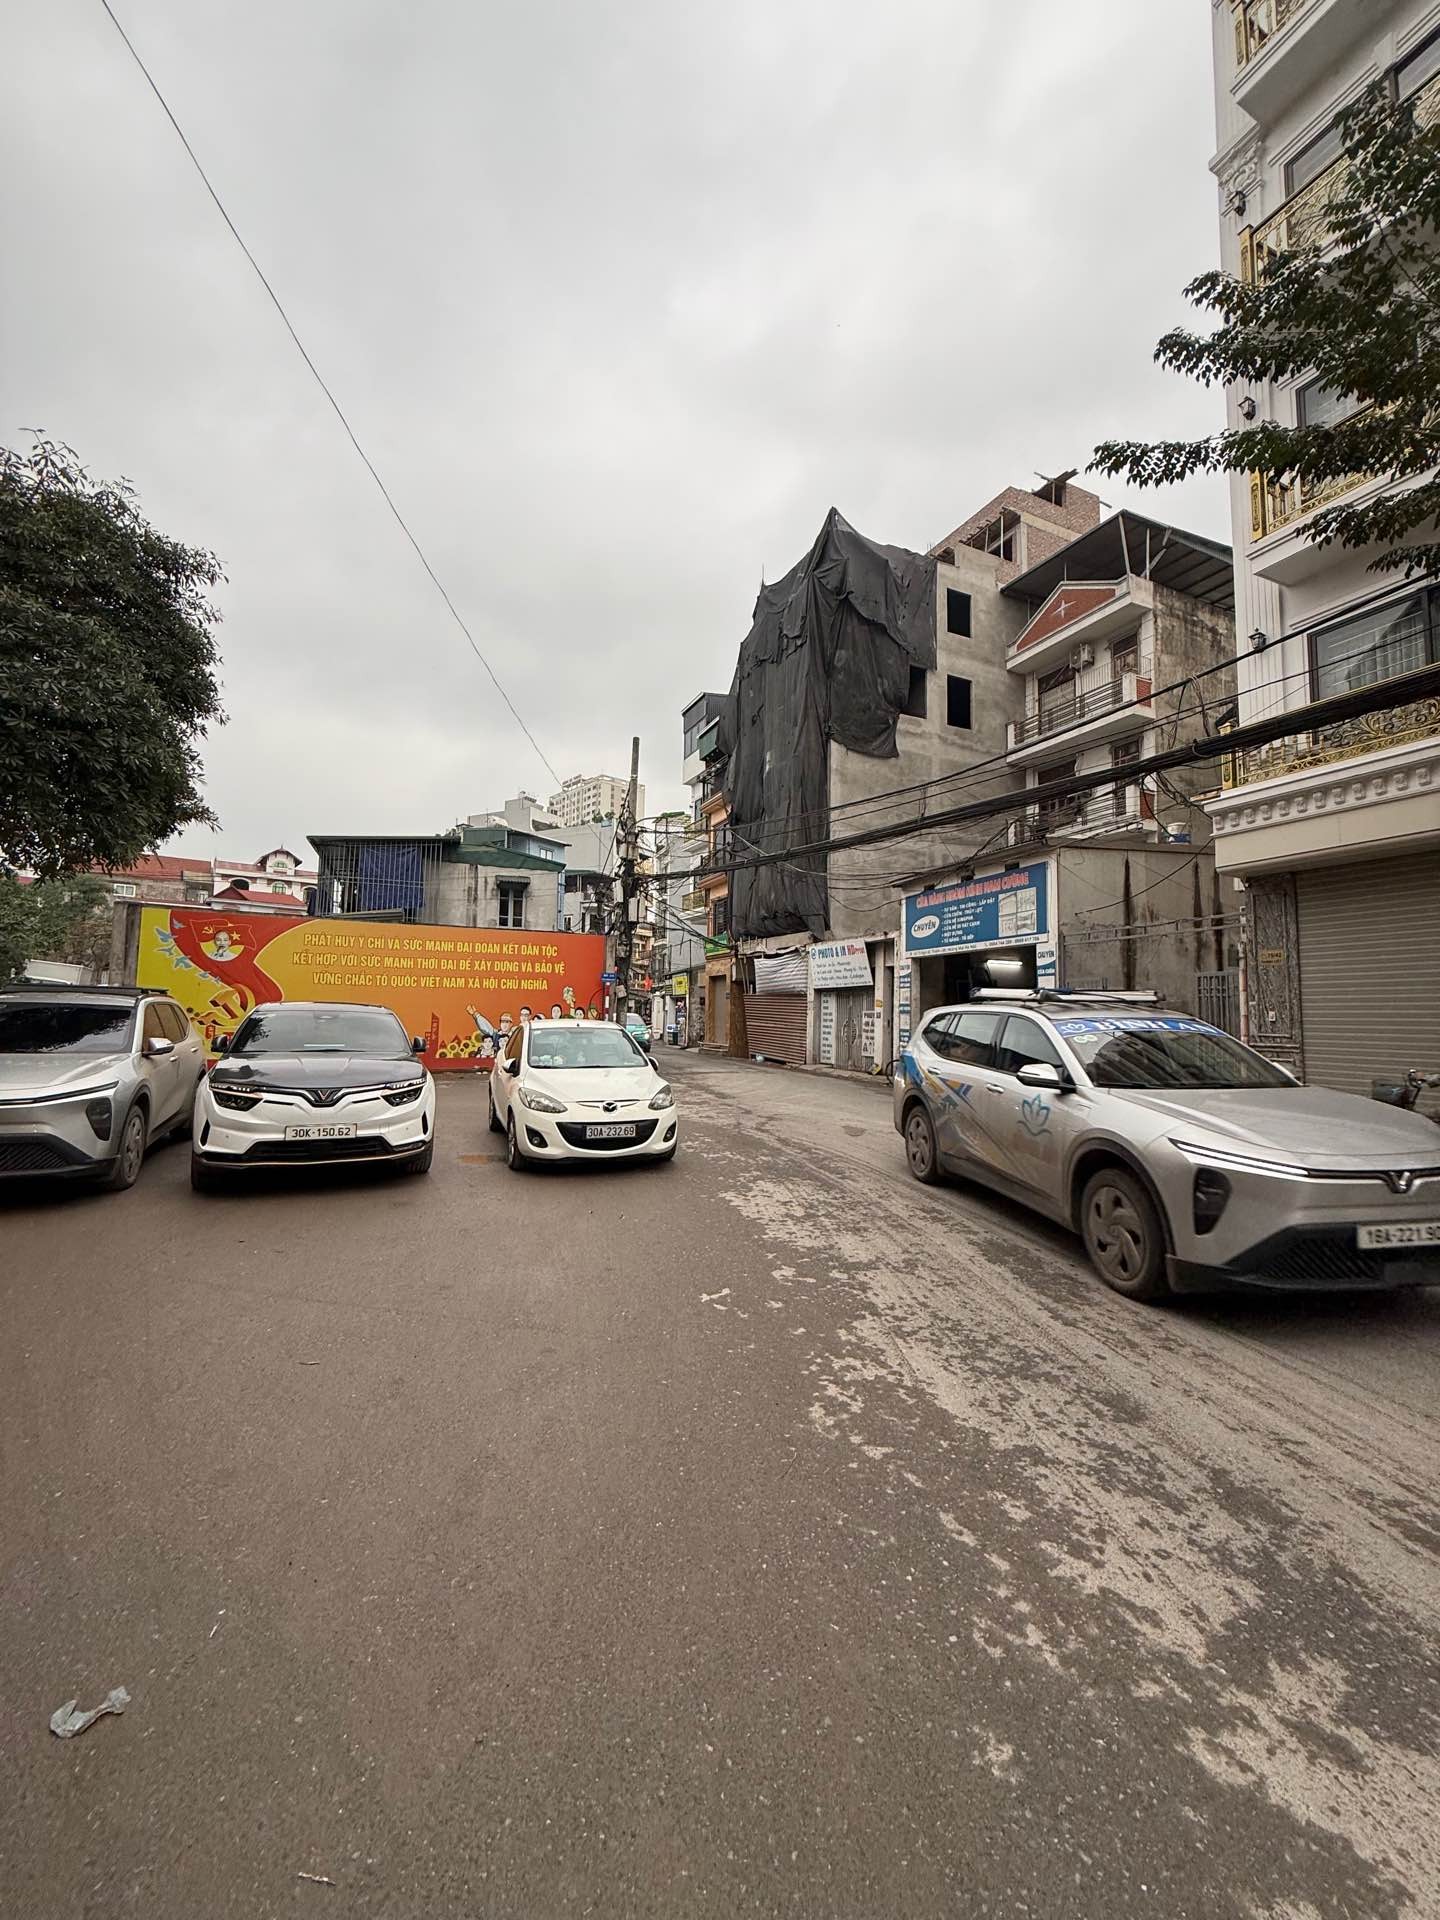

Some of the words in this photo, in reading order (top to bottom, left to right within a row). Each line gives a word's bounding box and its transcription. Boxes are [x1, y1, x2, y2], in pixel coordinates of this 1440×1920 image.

[913, 919, 937, 932] CHUYÊN
[335, 936, 356, 947] HUY
[425, 940, 455, 954] MẠNH
[818, 947, 834, 959] PHOTO
[360, 953, 381, 968] SỨC
[384, 957, 414, 970] MẠNH
[494, 960, 519, 974] DỰNG
[442, 977, 465, 989] NAM
[291, 1127, 351, 1138] 30K-150.62
[587, 1126, 635, 1137] 30A-232.69
